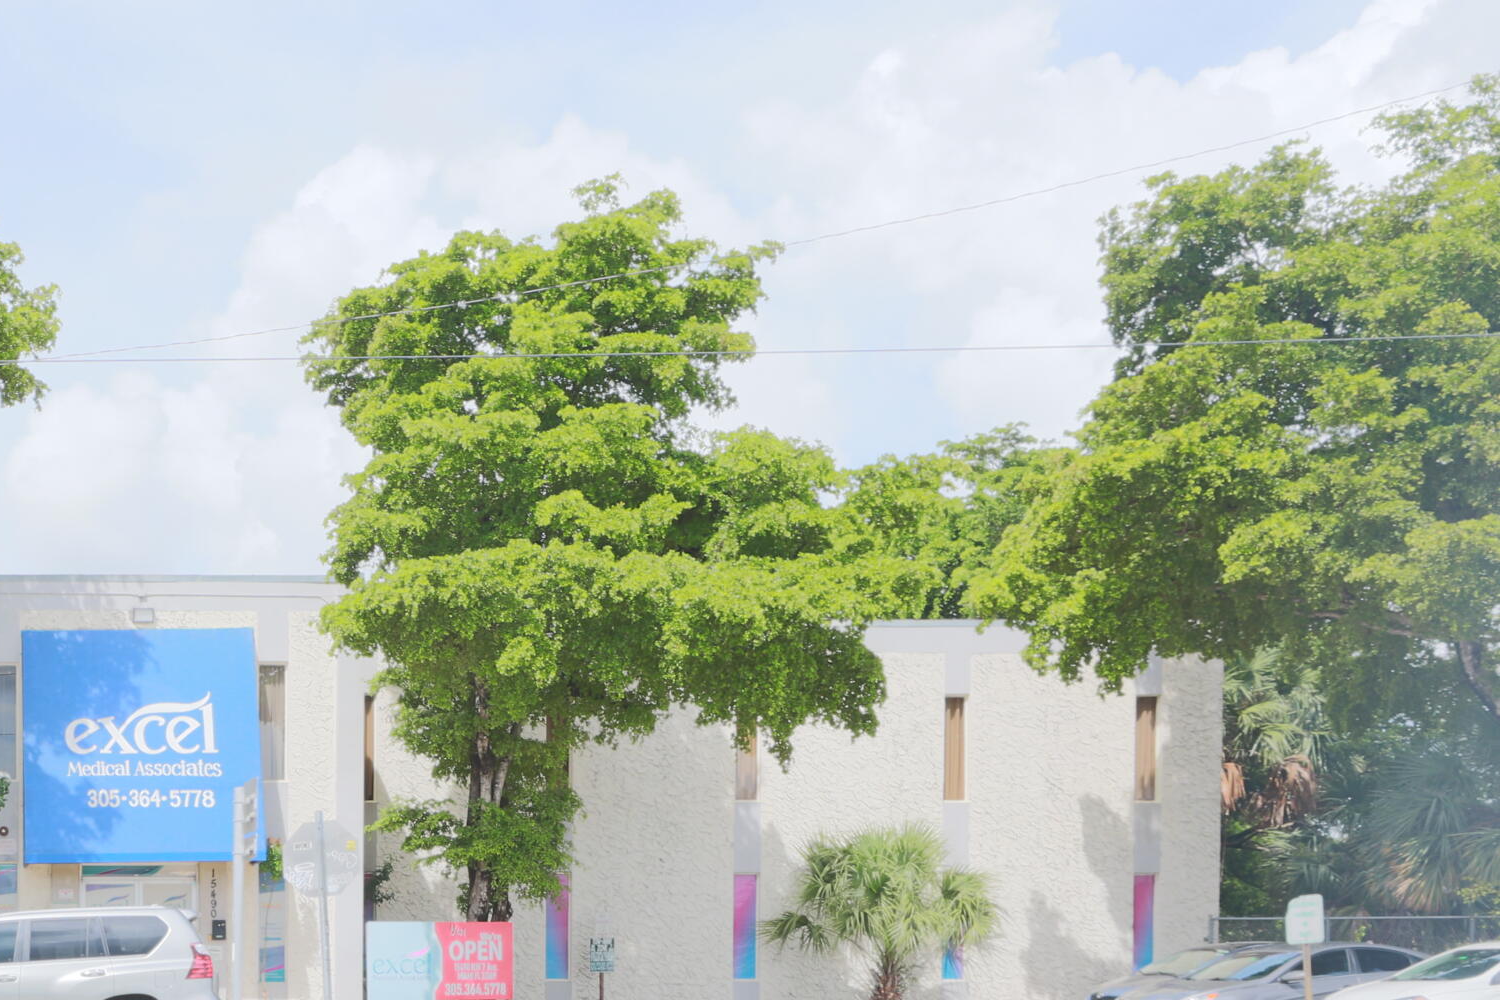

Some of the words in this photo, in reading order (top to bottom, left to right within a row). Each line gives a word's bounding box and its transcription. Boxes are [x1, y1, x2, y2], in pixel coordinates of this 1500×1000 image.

[64, 691, 219, 755] excel
[67, 760, 130, 777] Medical
[134, 760, 222, 777] Associates
[449, 940, 503, 961] OPEN
[373, 952, 433, 975] excel
